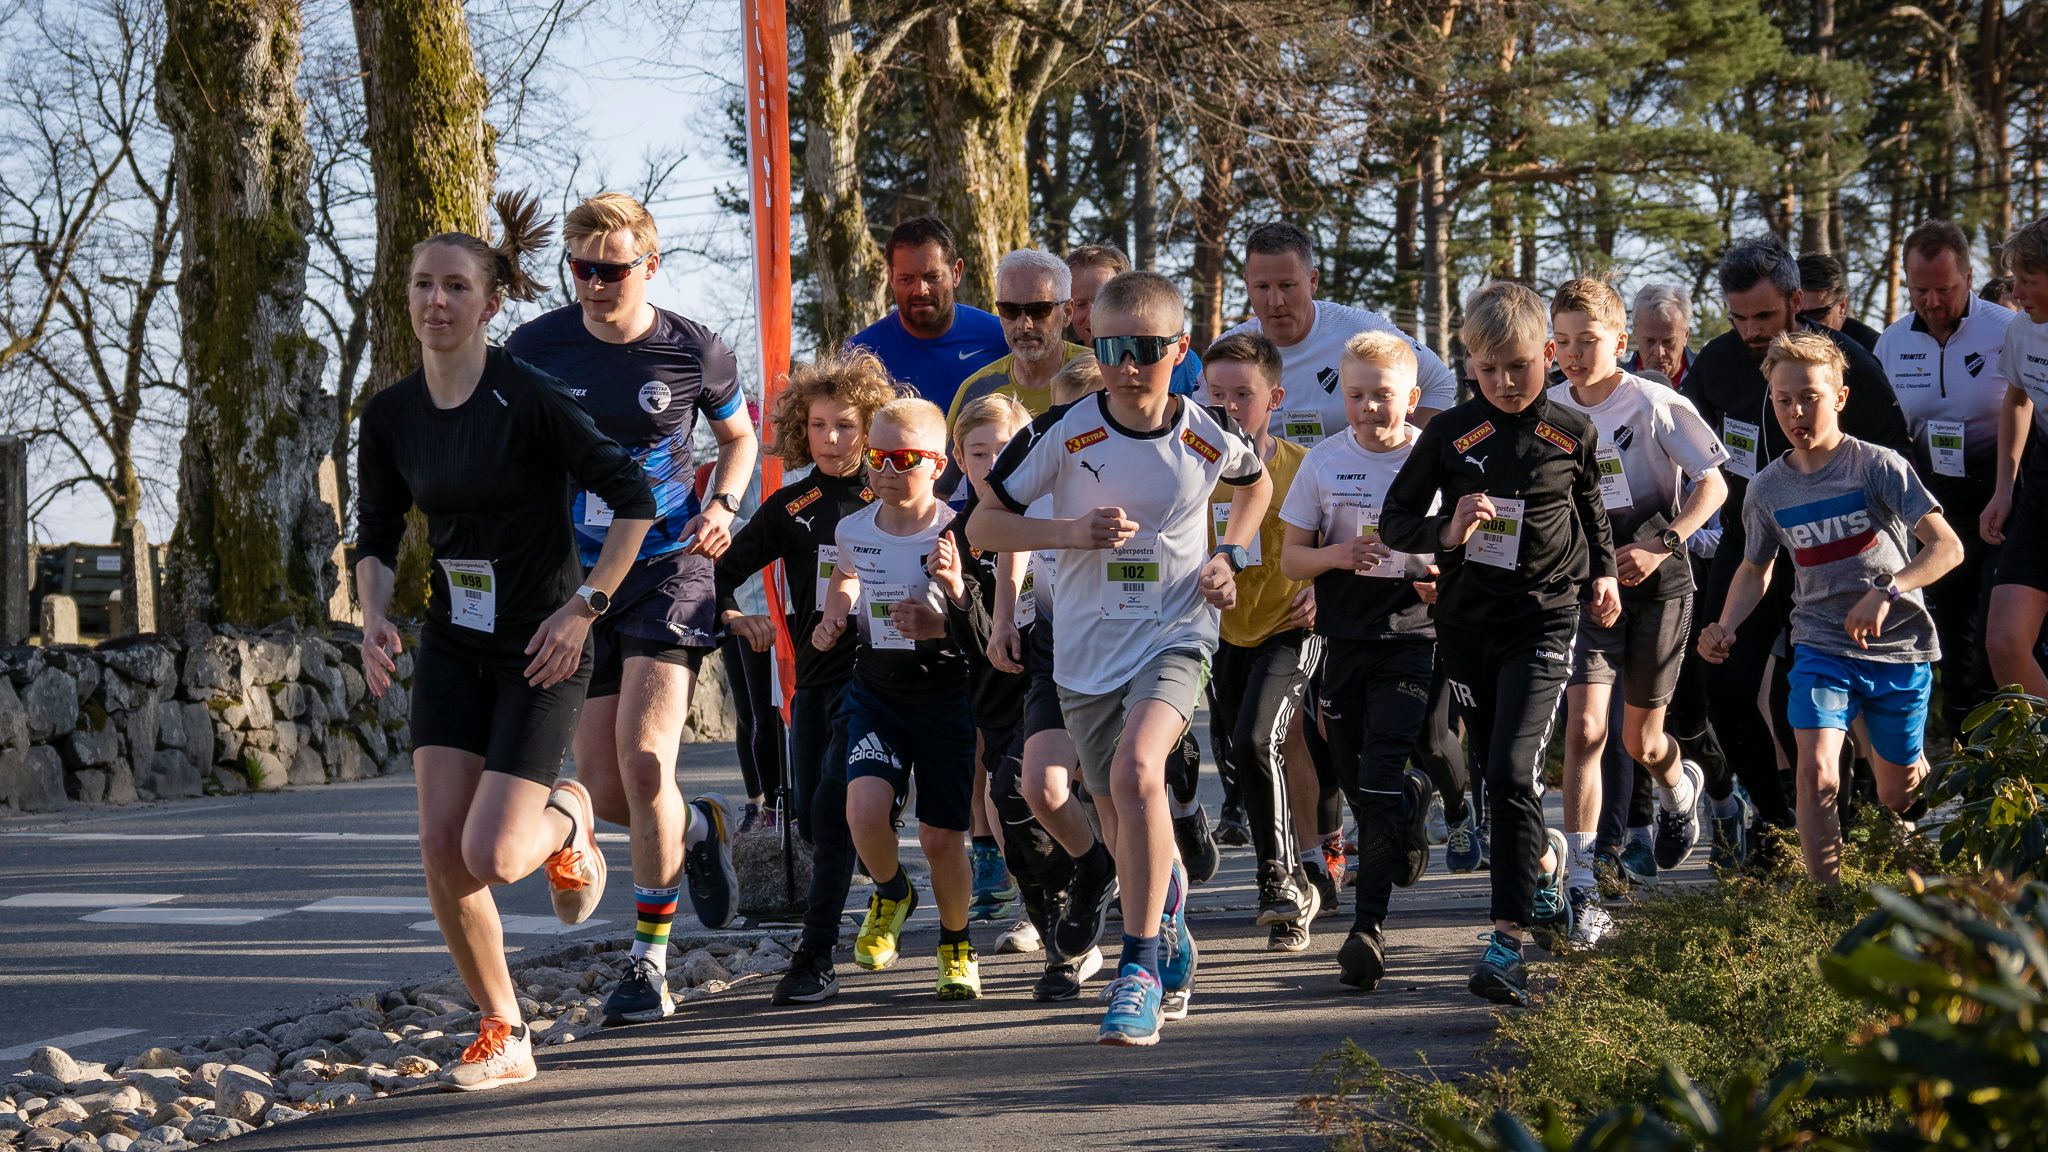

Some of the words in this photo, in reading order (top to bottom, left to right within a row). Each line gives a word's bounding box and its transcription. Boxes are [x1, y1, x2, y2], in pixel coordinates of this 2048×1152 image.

[1321, 371, 1338, 388] GRANE
[1294, 424, 1313, 435] 353
[1469, 425, 1492, 442] EXTRA
[1080, 430, 1107, 445] EXTRA
[1551, 431, 1574, 451] EXTRA
[1194, 441, 1217, 461] EXTRA
[799, 491, 819, 506] EXTRA
[1482, 519, 1506, 532] 308
[1789, 509, 1871, 549] evi's
[853, 545, 882, 555] TRIMTEX
[1111, 547, 1154, 557] Agderposten
[1121, 565, 1145, 579] 102
[461, 574, 482, 588] 098
[871, 589, 905, 598] Agderposten
[1535, 648, 1566, 661] hummel
[848, 749, 890, 765] adidas
